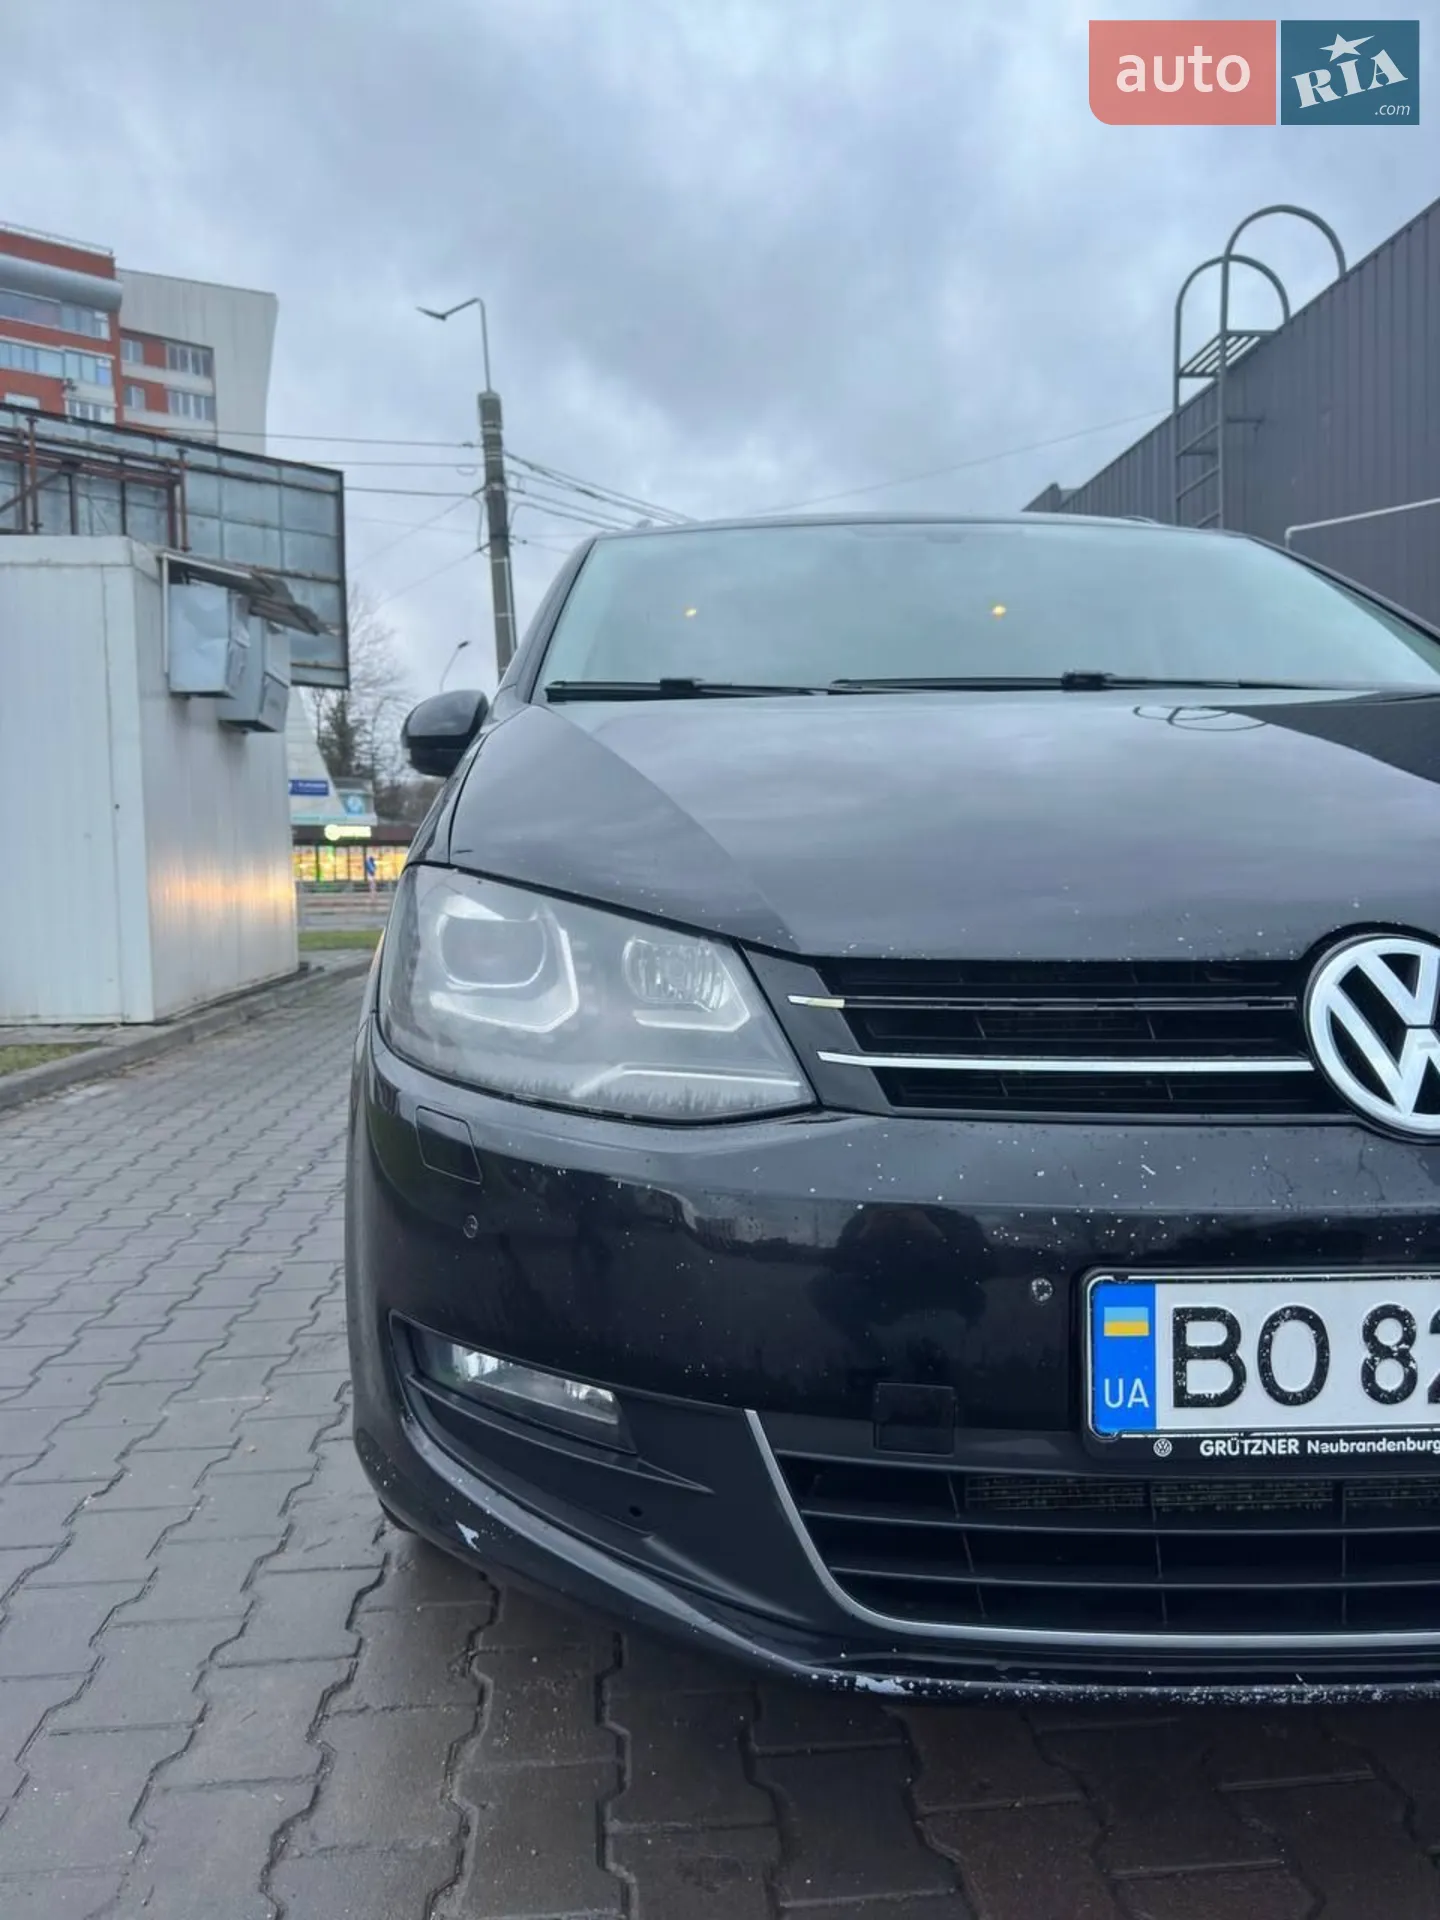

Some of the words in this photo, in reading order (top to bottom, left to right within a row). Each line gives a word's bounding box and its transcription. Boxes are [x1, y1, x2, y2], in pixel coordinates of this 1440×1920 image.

[1172, 1304, 1331, 1409] BO
[1360, 1303, 1440, 1406] 8
[1103, 1378, 1150, 1409] UA
[1199, 1437, 1300, 1456] GRÜTZNER
